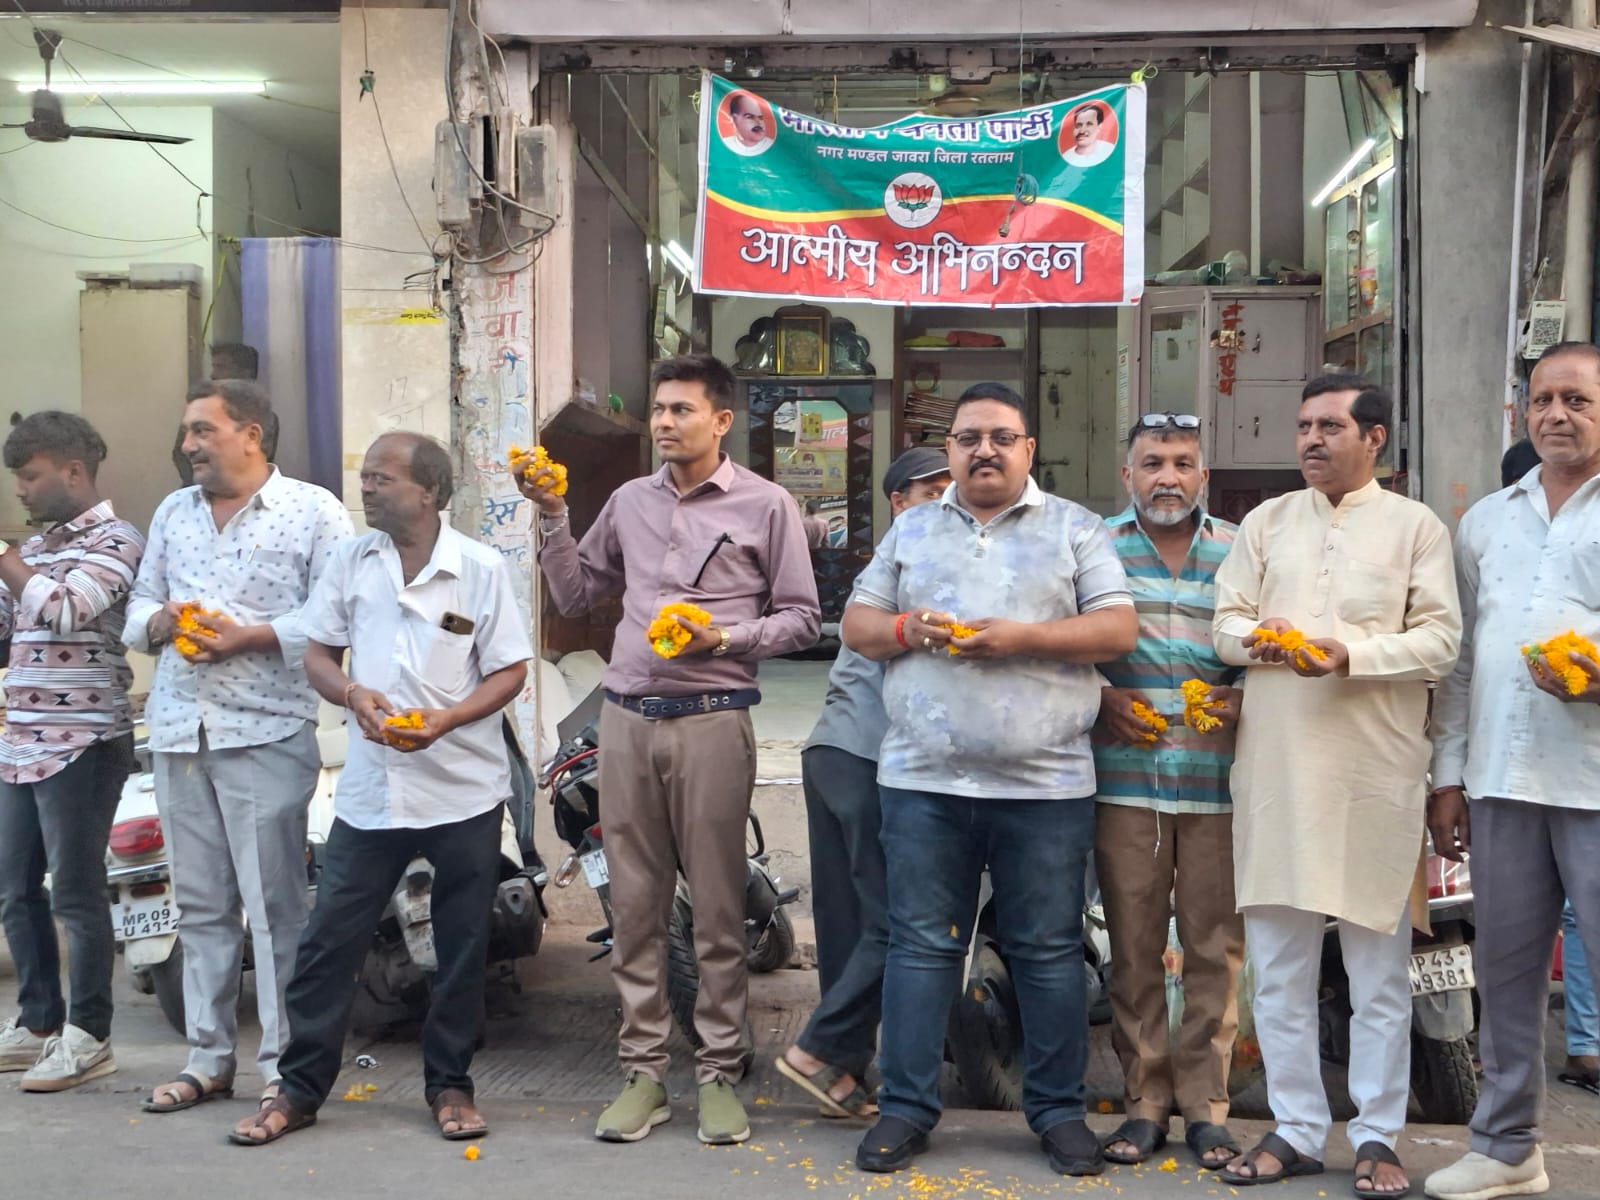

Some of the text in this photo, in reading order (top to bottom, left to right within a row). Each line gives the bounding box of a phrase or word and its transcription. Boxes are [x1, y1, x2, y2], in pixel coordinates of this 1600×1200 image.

[986, 109, 1053, 142] पार्टी
[817, 145, 1014, 163] नगर मण्डल जावरा जिला रतलाम
[739, 224, 1086, 295] आत्मीय अभिनन्दन
[1431, 949, 1455, 968] 43
